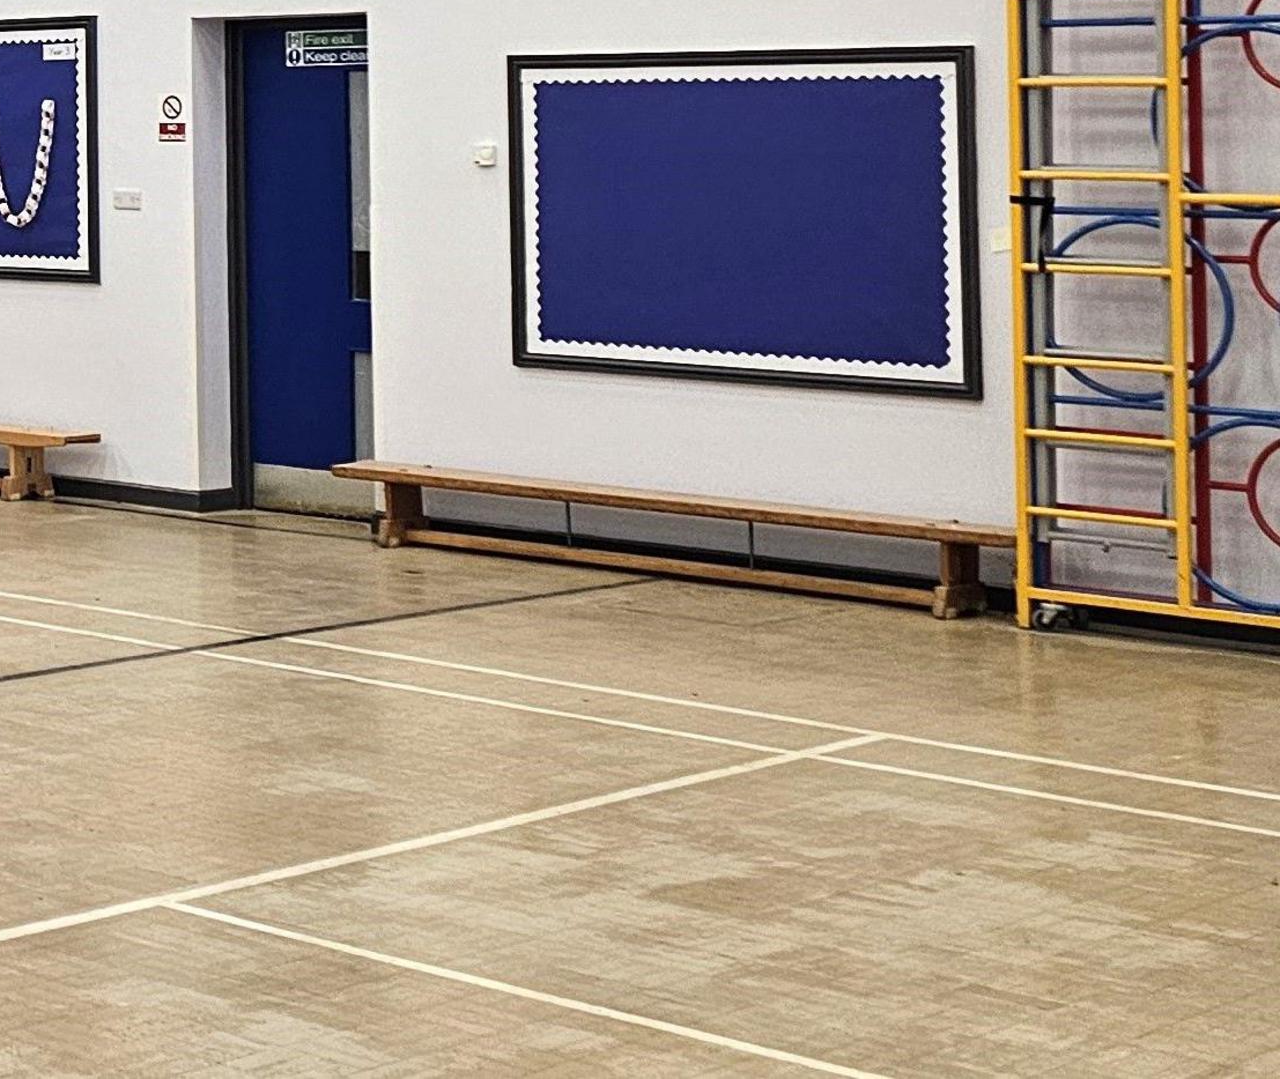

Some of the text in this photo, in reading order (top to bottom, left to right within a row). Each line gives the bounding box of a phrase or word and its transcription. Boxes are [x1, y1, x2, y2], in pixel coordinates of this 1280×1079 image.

[304, 33, 354, 46] Fire exit
[305, 50, 368, 63] Keep clea
